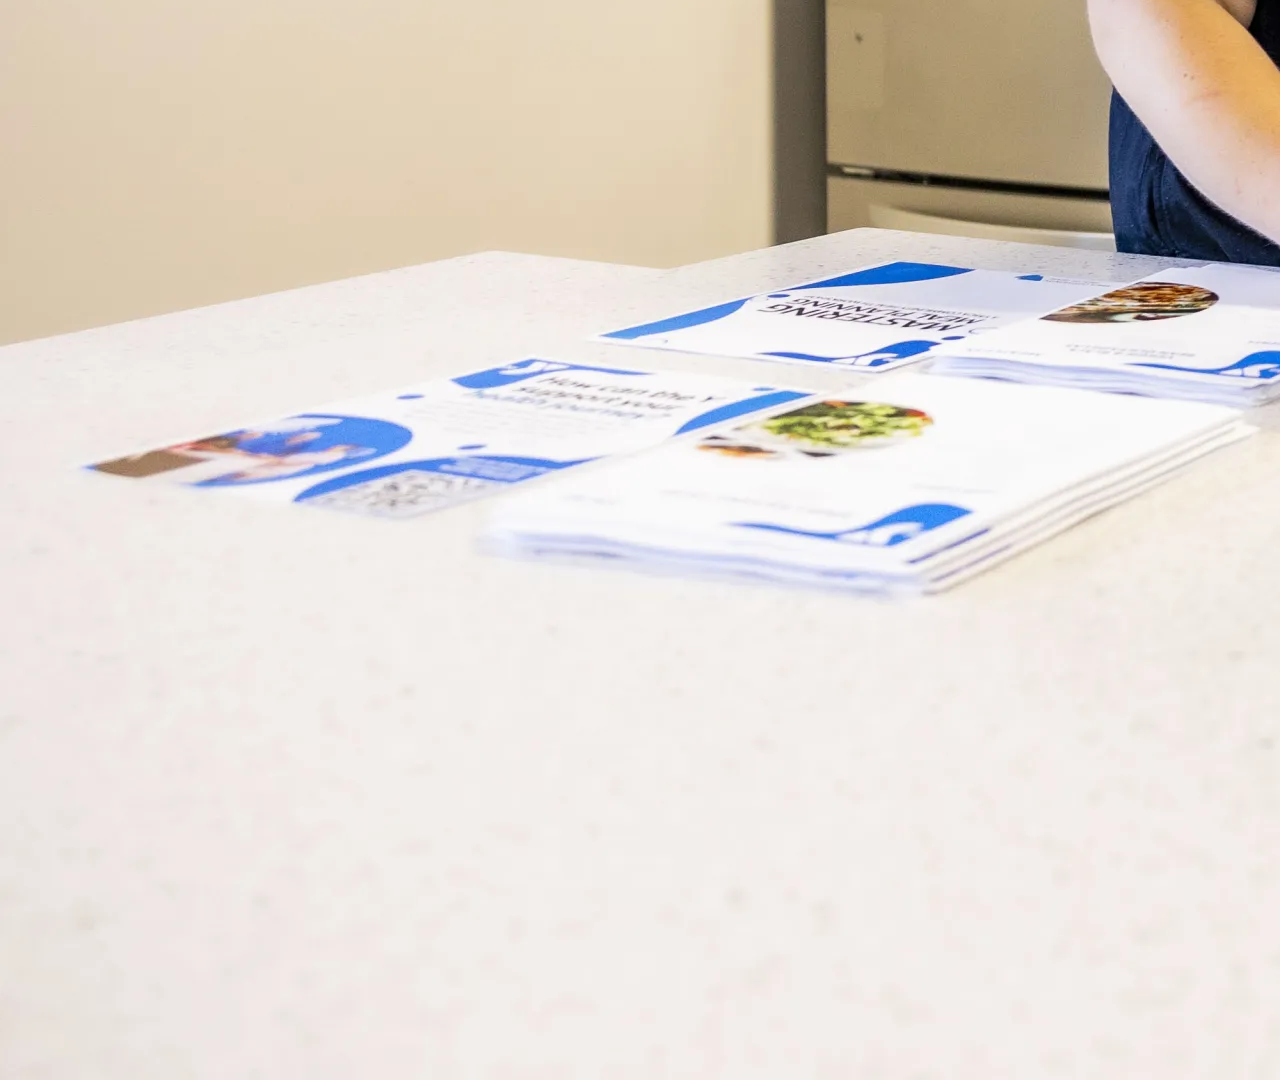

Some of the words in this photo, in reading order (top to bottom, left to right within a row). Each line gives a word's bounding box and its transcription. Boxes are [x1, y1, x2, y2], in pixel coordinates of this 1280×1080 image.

[785, 298, 915, 317] PLANNING
[757, 304, 964, 332] MASTERING
[919, 313, 984, 324] MEAL
